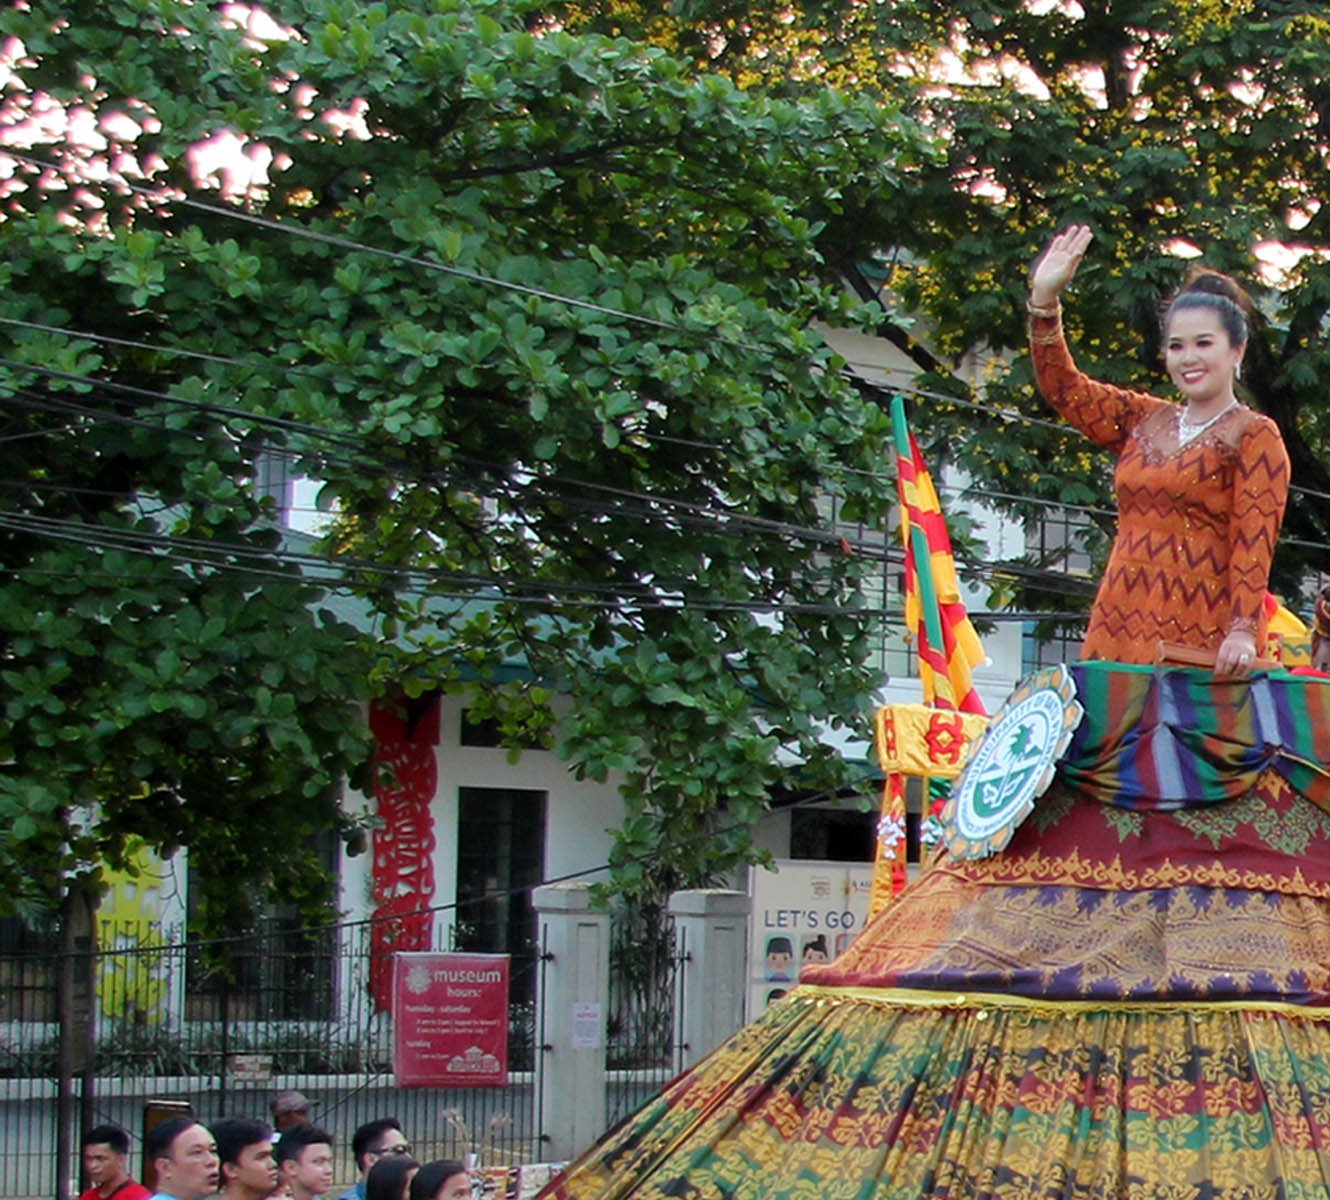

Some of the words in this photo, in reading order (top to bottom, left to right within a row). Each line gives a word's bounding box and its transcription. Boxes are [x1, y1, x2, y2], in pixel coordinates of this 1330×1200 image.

[764, 910, 818, 928] LET'S
[825, 910, 855, 929] GO
[434, 970, 502, 983] museum
[447, 986, 482, 998] hours:
